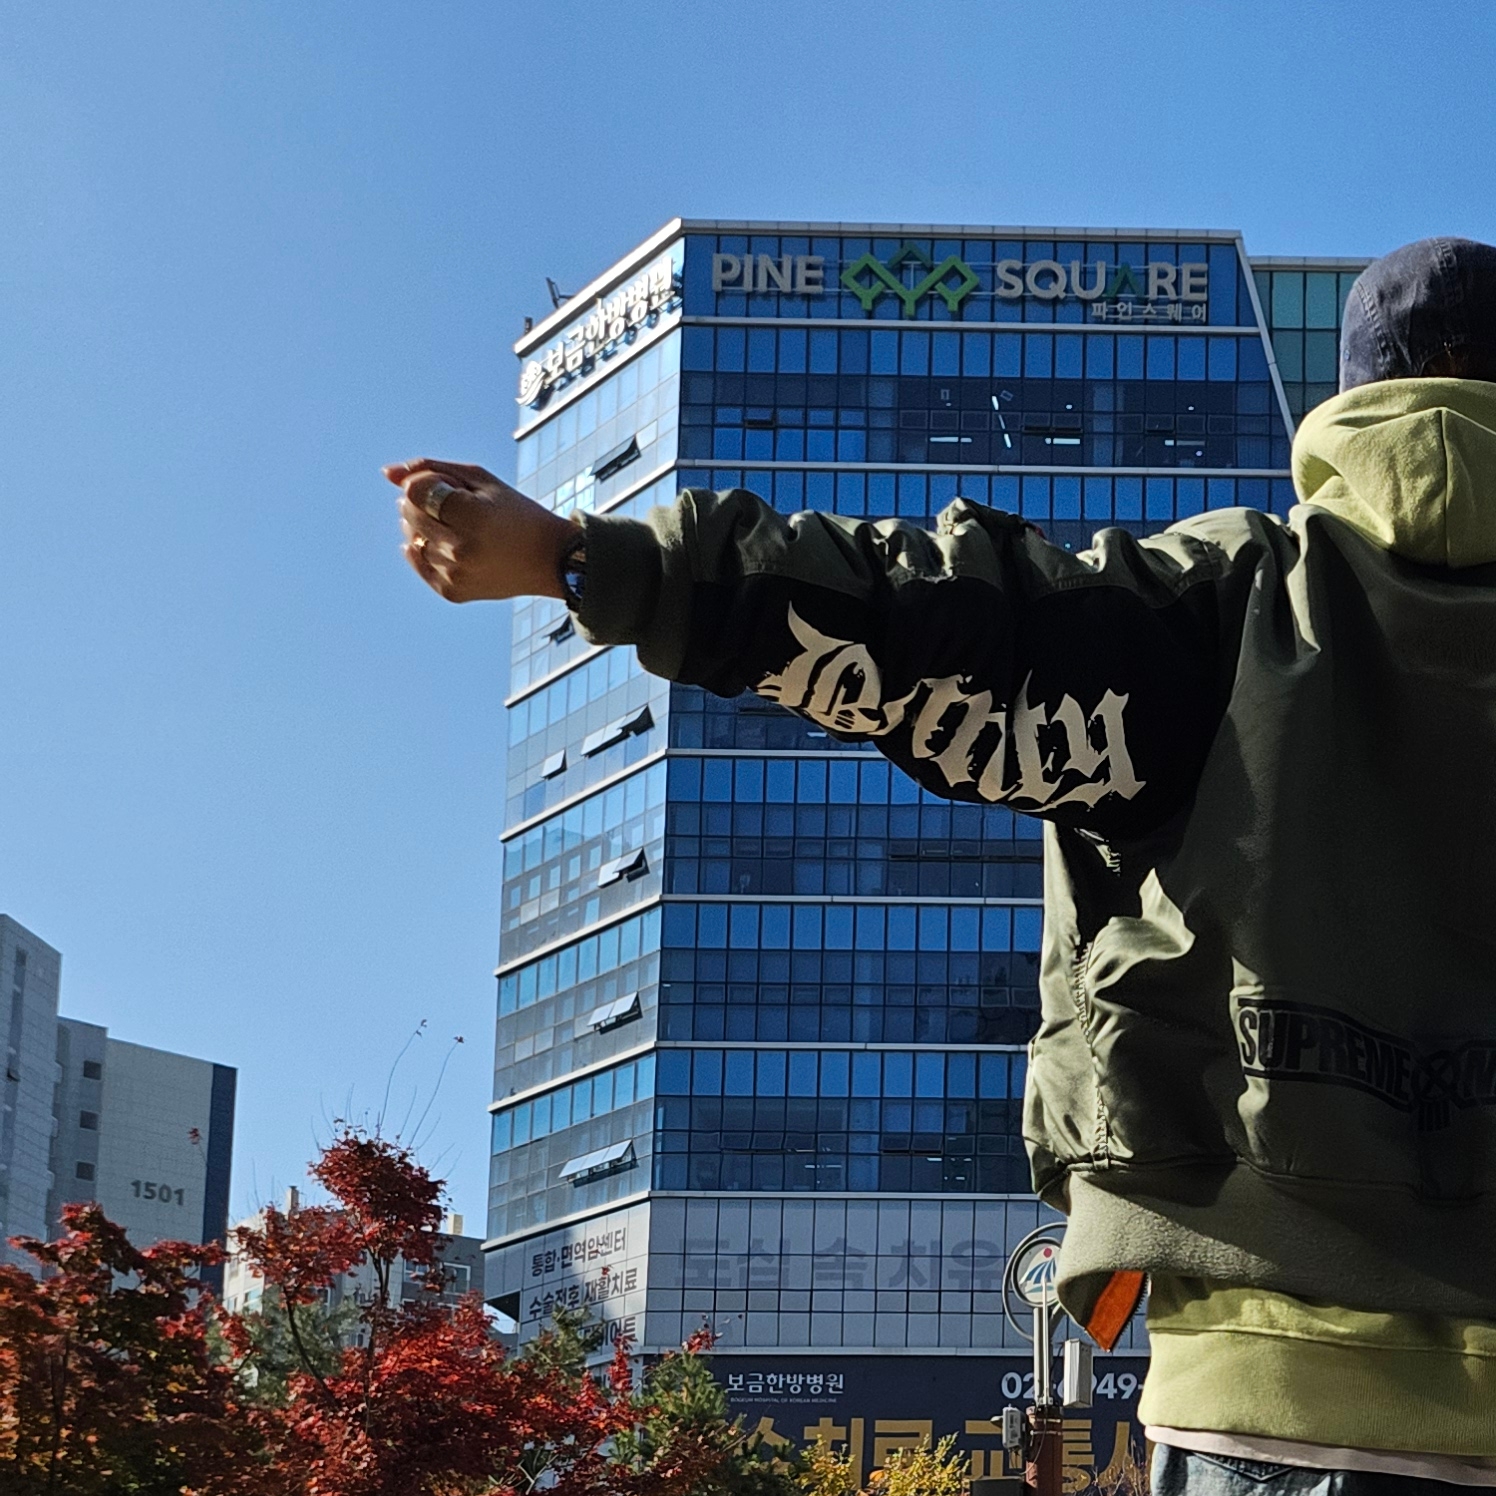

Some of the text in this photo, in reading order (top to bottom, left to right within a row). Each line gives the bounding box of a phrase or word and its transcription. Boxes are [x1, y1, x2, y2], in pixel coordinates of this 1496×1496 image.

[712, 253, 824, 294] PINE
[1238, 1006, 1414, 1102] SUPREME
[130, 1179, 185, 1207] 1501
[585, 1268, 638, 1302] 재활치료
[727, 1373, 844, 1395] 보금한방병원
